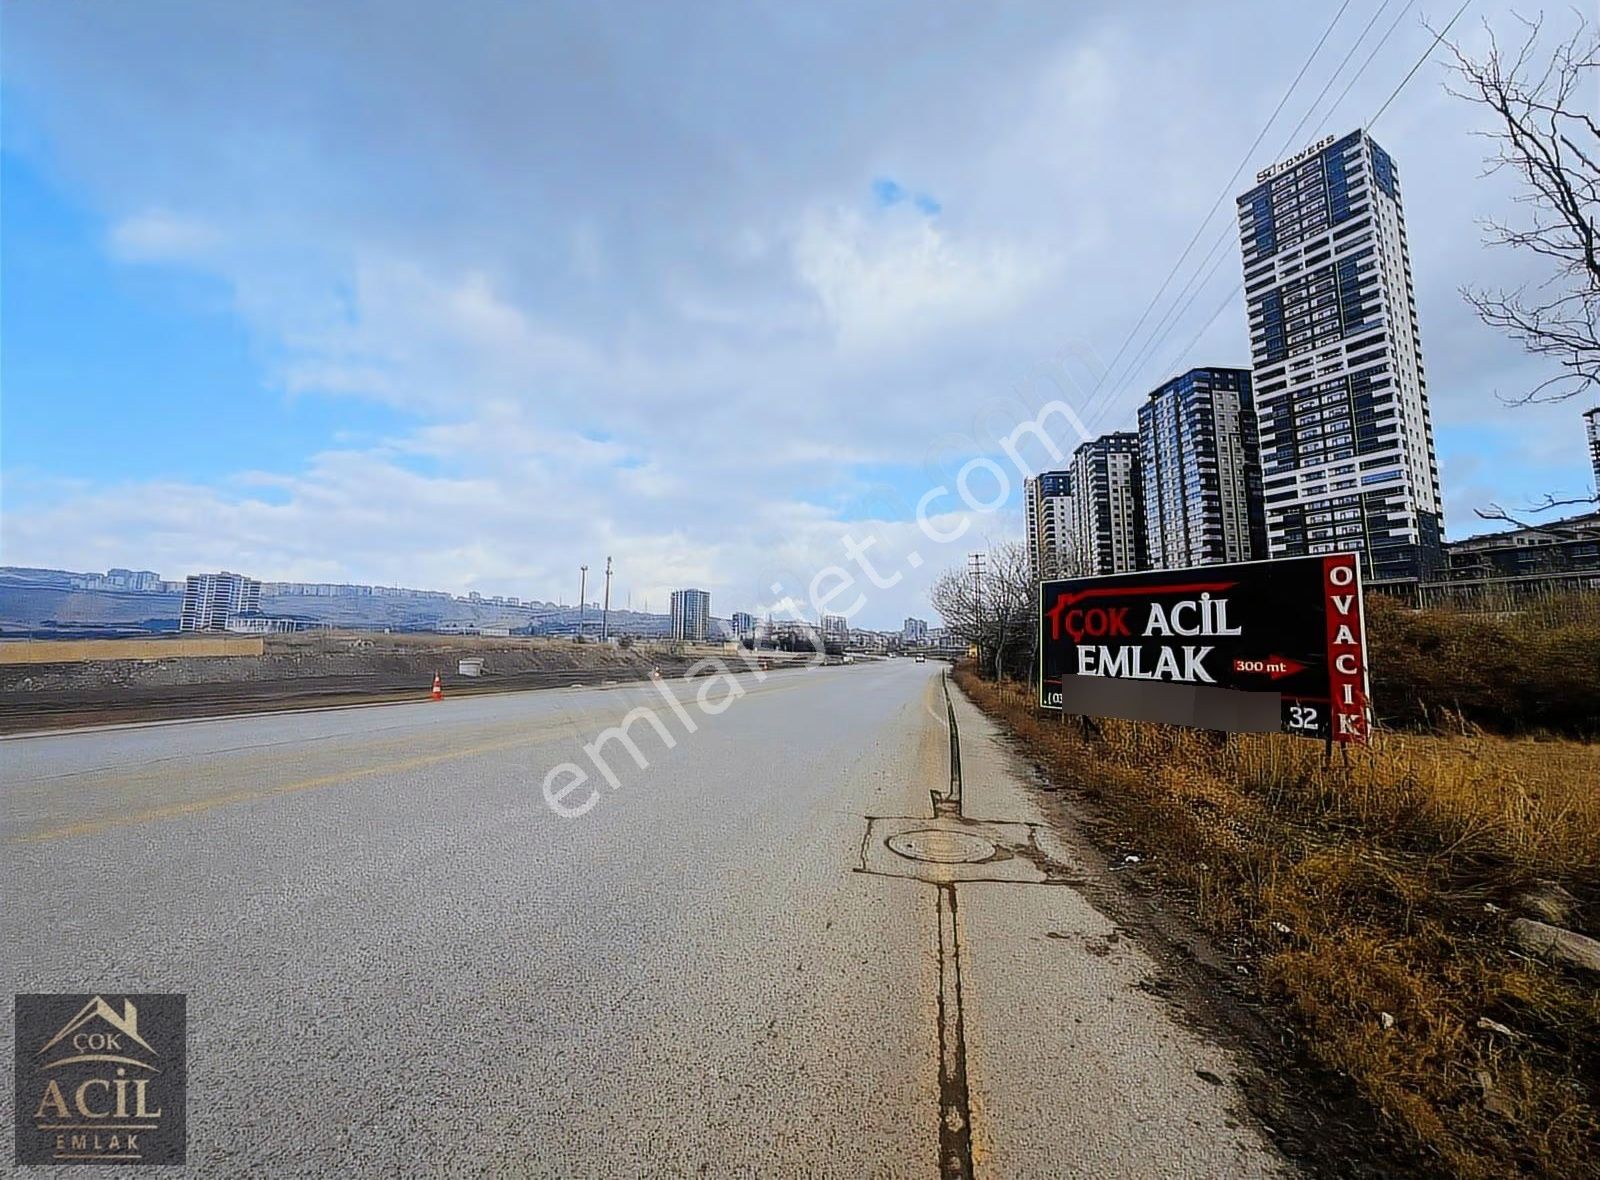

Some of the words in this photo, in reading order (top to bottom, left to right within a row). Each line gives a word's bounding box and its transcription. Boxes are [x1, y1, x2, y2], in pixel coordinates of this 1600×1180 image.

[1278, 134, 1335, 172] TOWERS
[1065, 608, 1131, 643] ÇOK
[1141, 592, 1242, 636] ACİL
[1077, 645, 1217, 683] EMLAK
[1236, 660, 1263, 671] 300
[1266, 662, 1287, 672] mt
[1330, 566, 1360, 736] OVACIK
[1289, 706, 1319, 729] 32
